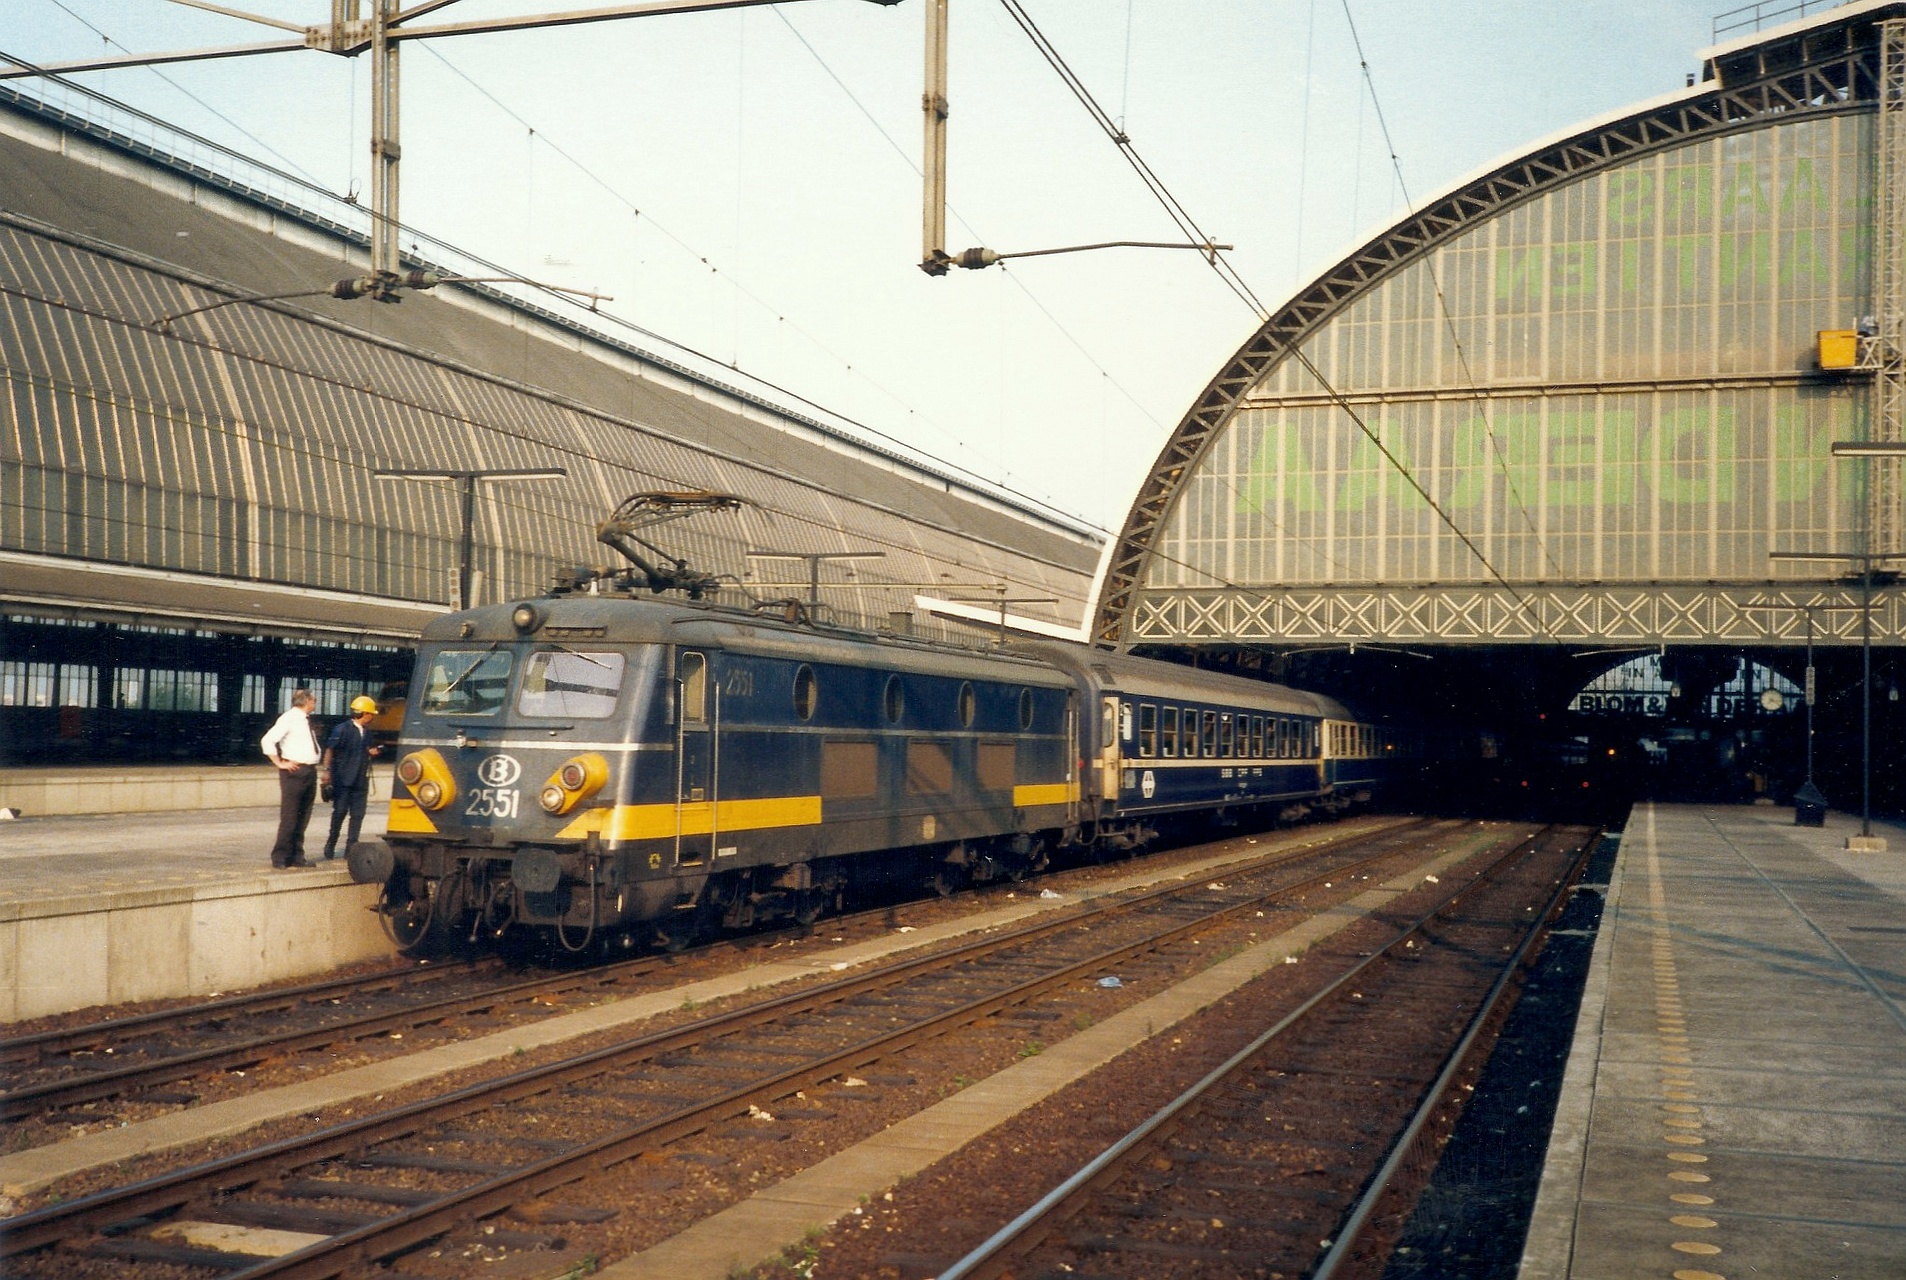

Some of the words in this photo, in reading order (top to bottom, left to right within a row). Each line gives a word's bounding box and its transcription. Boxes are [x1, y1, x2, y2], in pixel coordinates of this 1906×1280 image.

[726, 668, 753, 697] 2551
[1580, 695, 1644, 714] BLOM
[1647, 696, 1664, 714] &
[465, 788, 520, 818] 2551
